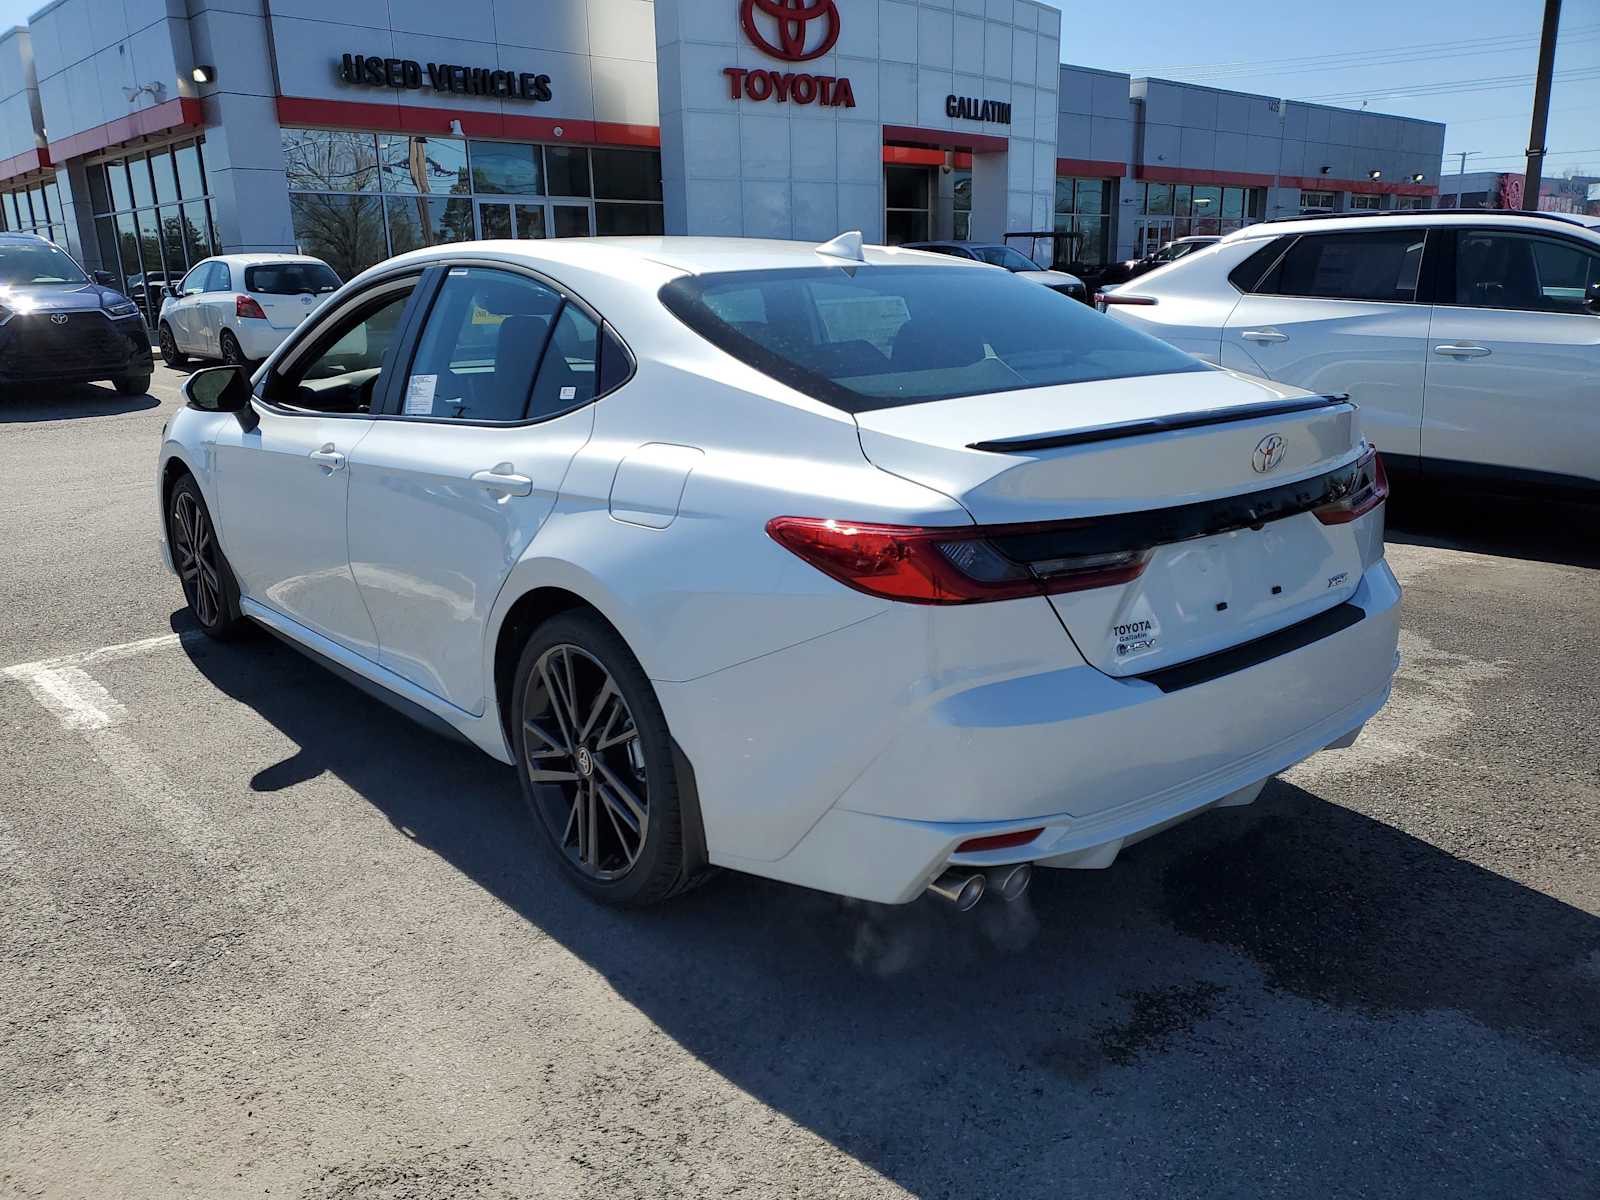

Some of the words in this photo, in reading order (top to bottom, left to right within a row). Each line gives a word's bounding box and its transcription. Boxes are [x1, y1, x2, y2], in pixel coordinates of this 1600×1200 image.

[340, 53, 423, 89] USED
[427, 62, 553, 102] VEHICLES
[723, 67, 856, 108] TOYOTA
[945, 94, 1012, 125] GALLATIN
[1113, 620, 1152, 636] TOYOTA
[1119, 632, 1148, 642] Gallatin
